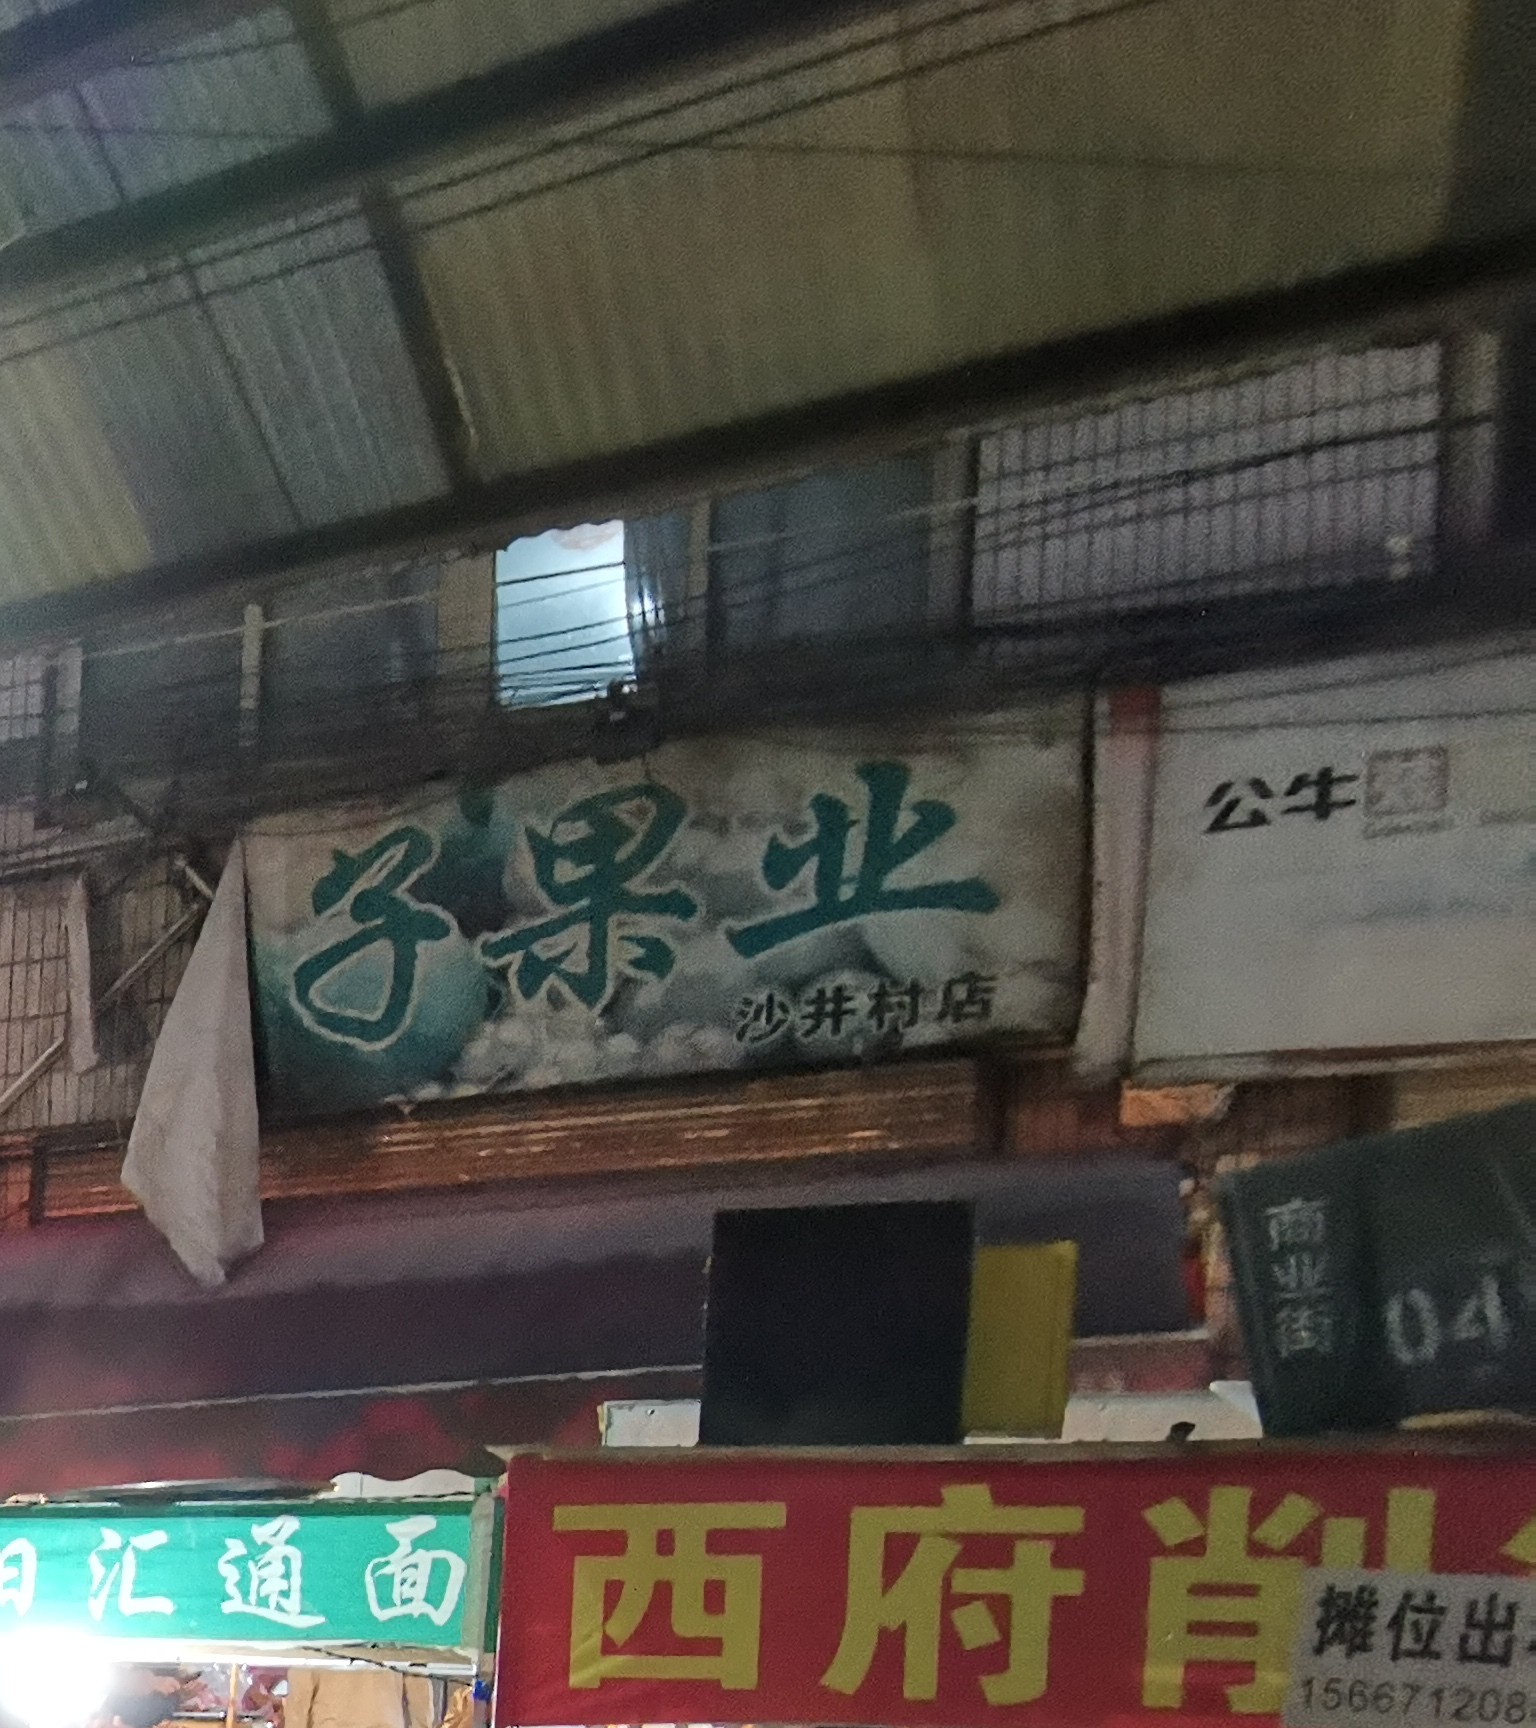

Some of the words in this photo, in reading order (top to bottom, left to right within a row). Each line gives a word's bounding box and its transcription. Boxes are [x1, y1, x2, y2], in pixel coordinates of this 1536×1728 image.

[1203, 766, 1359, 833] 公牛
[290, 757, 1002, 1050] 子果业
[736, 971, 997, 1043] 沙井村店
[1311, 1583, 1536, 1668] 摊位出
[1299, 1676, 1536, 1725] 156671208
